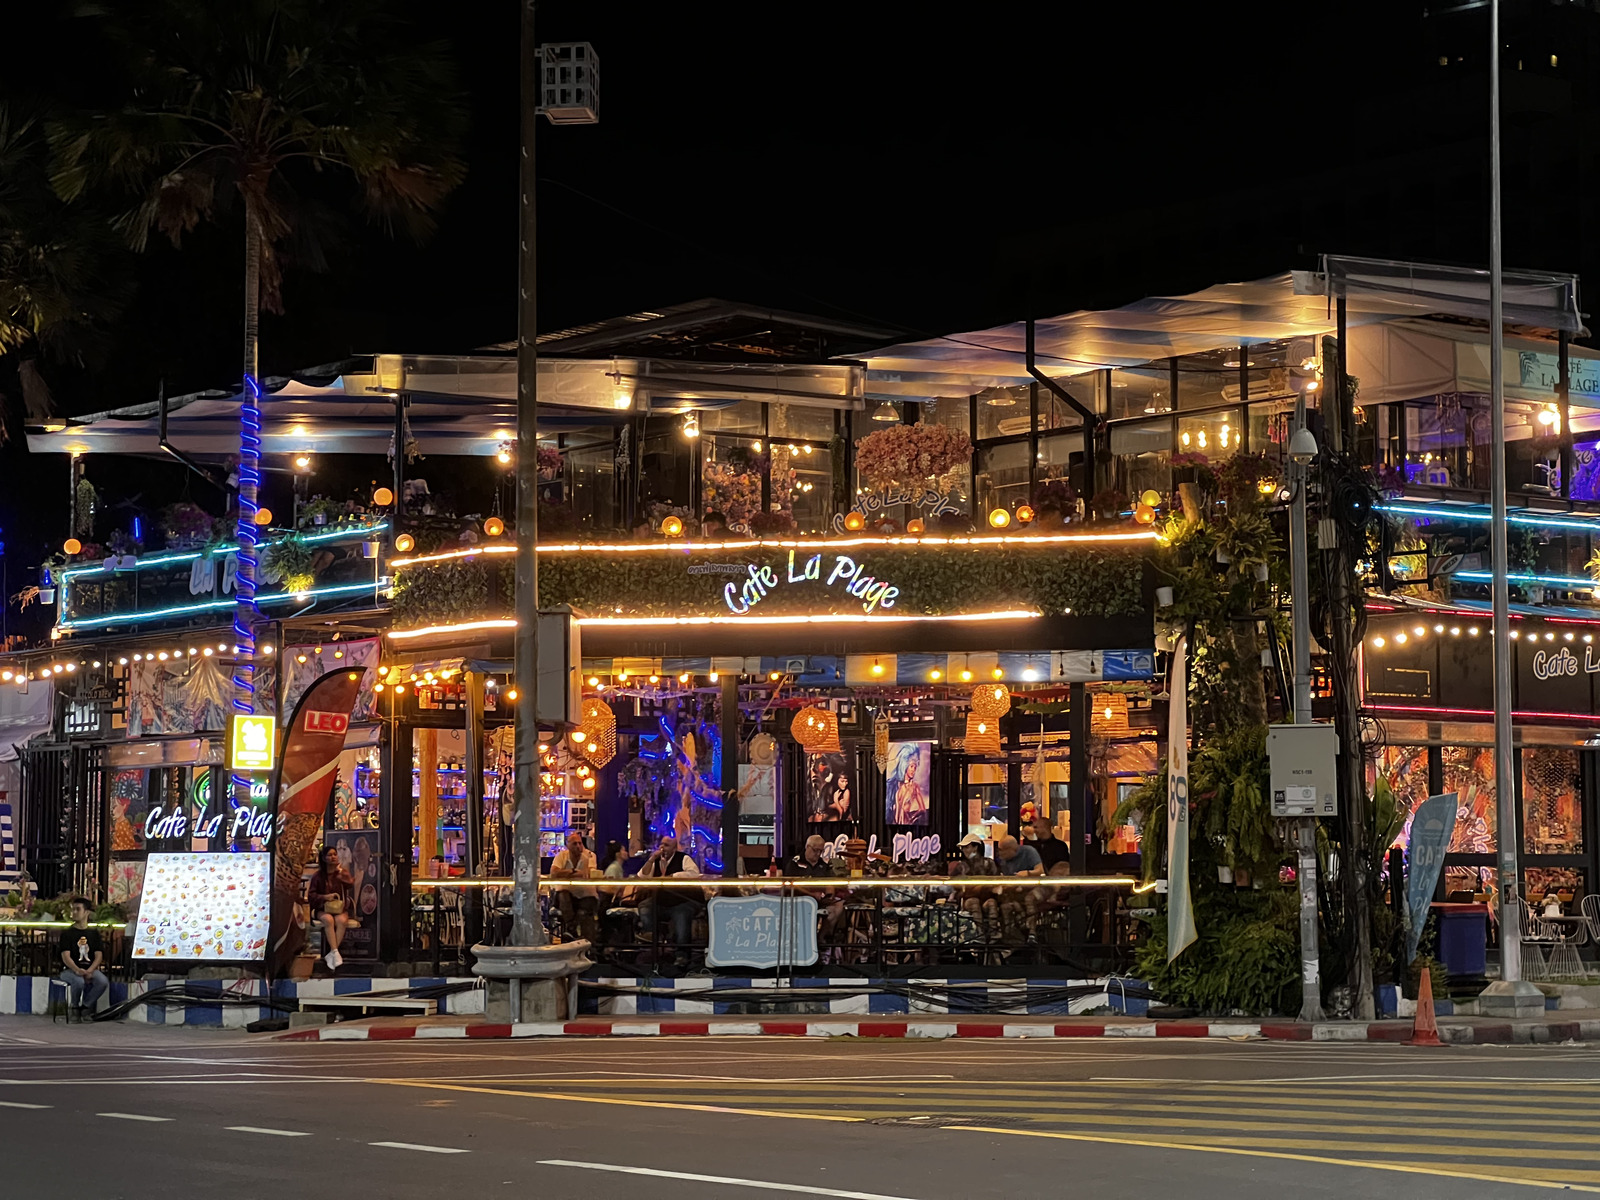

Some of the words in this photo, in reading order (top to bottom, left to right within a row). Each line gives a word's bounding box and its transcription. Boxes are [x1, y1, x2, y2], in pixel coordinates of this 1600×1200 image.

[724, 563, 779, 614] Cafe
[788, 549, 822, 583] La
[826, 555, 900, 614] Plage
[1533, 646, 1578, 680] Cafe
[1585, 645, 1600, 673] L
[306, 711, 348, 733] LEO
[144, 806, 188, 840] Cafe
[192, 805, 225, 838] La
[892, 831, 941, 864] Plage
[735, 937, 750, 947] La
